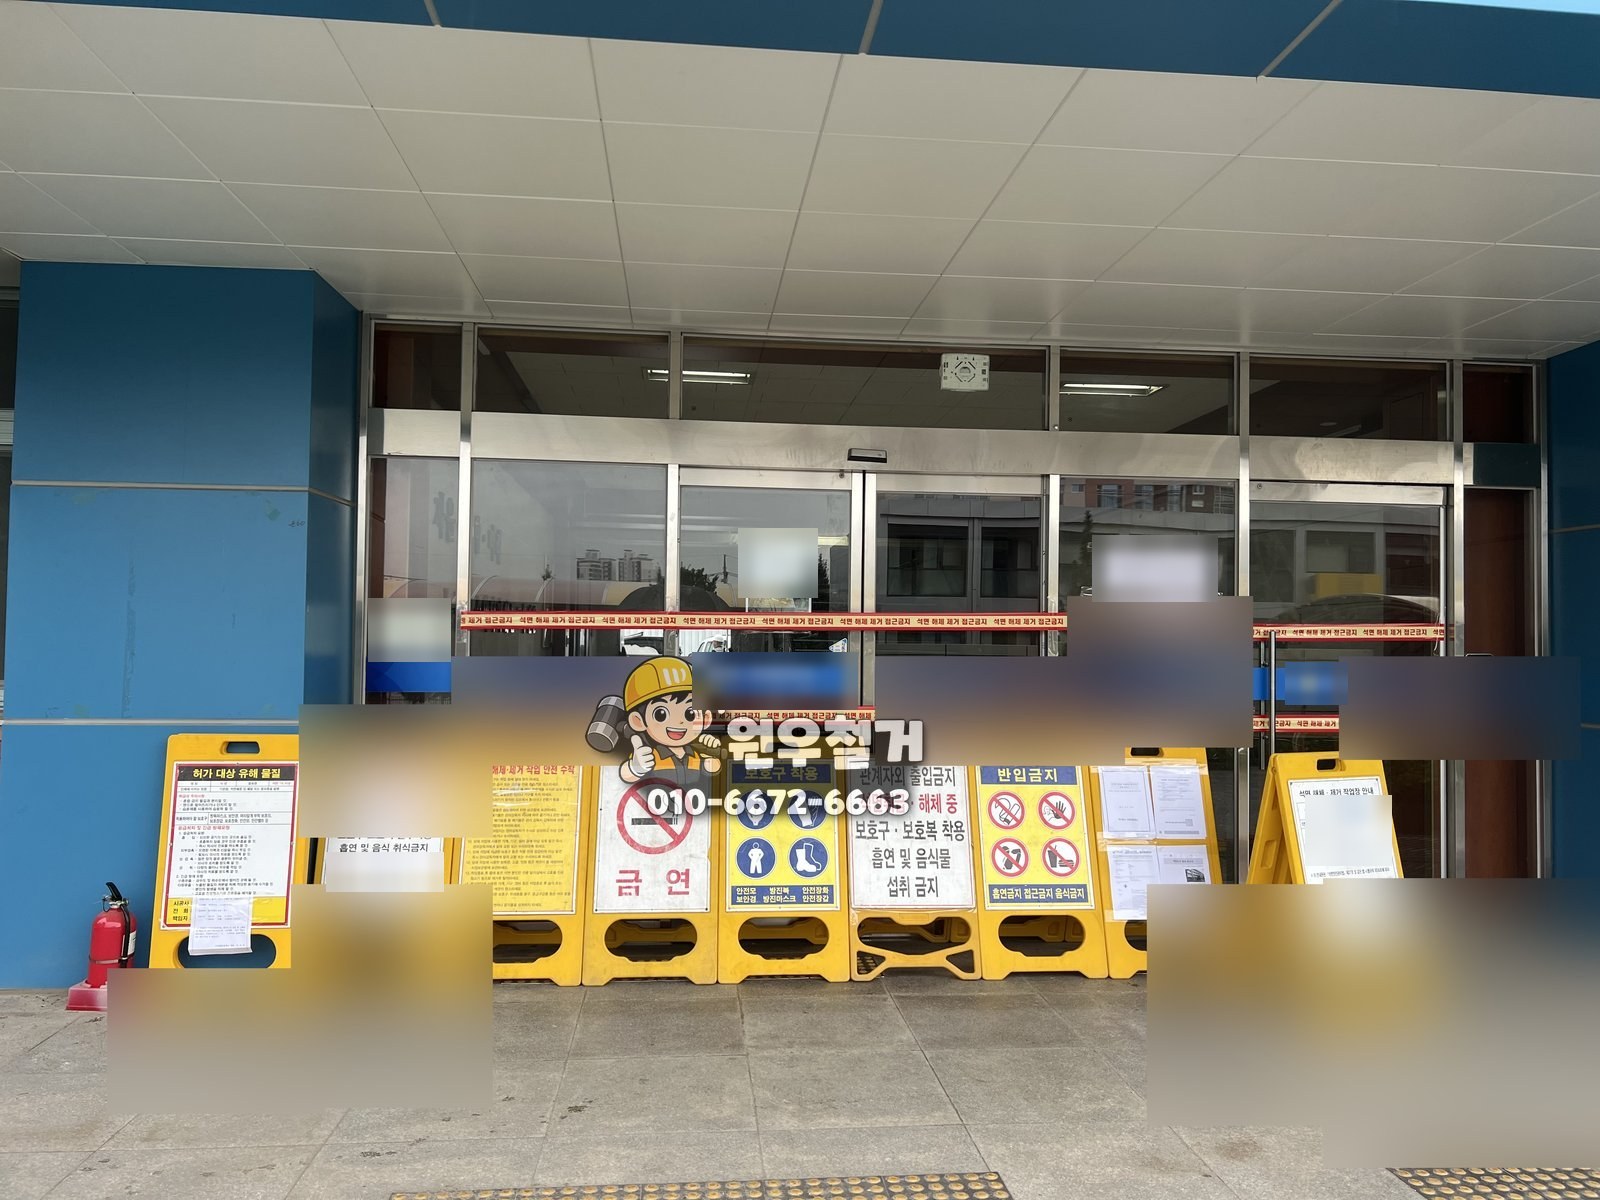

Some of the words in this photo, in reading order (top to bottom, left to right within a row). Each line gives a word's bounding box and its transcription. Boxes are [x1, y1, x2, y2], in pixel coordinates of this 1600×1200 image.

[193, 769, 212, 779] 허가
[216, 769, 235, 779] 대상
[239, 769, 258, 779] 유해
[261, 769, 280, 779] 물질
[791, 767, 818, 780] 착용
[860, 767, 905, 786] 관계자외
[910, 767, 955, 786] 출입금지
[998, 768, 1058, 782] 반입금지
[919, 793, 942, 813] 해체
[946, 794, 957, 814] 중
[856, 821, 889, 840] 보호구
[903, 821, 937, 841] 보호복
[942, 821, 965, 841] 착용
[340, 844, 357, 852] 흡연
[361, 844, 368, 852] 및
[372, 844, 390, 852] 음식
[393, 844, 428, 852] 취식금지
[872, 848, 895, 868] 흡연
[900, 848, 911, 869] 및
[916, 848, 950, 869] 음식물
[616, 869, 642, 896] 금
[666, 868, 690, 896] 연
[887, 876, 910, 897] 섭취
[915, 876, 938, 897] 금지
[992, 888, 1022, 899] 흡연금지
[1024, 888, 1053, 899] 접근금지
[1055, 888, 1084, 899] 음식금지
